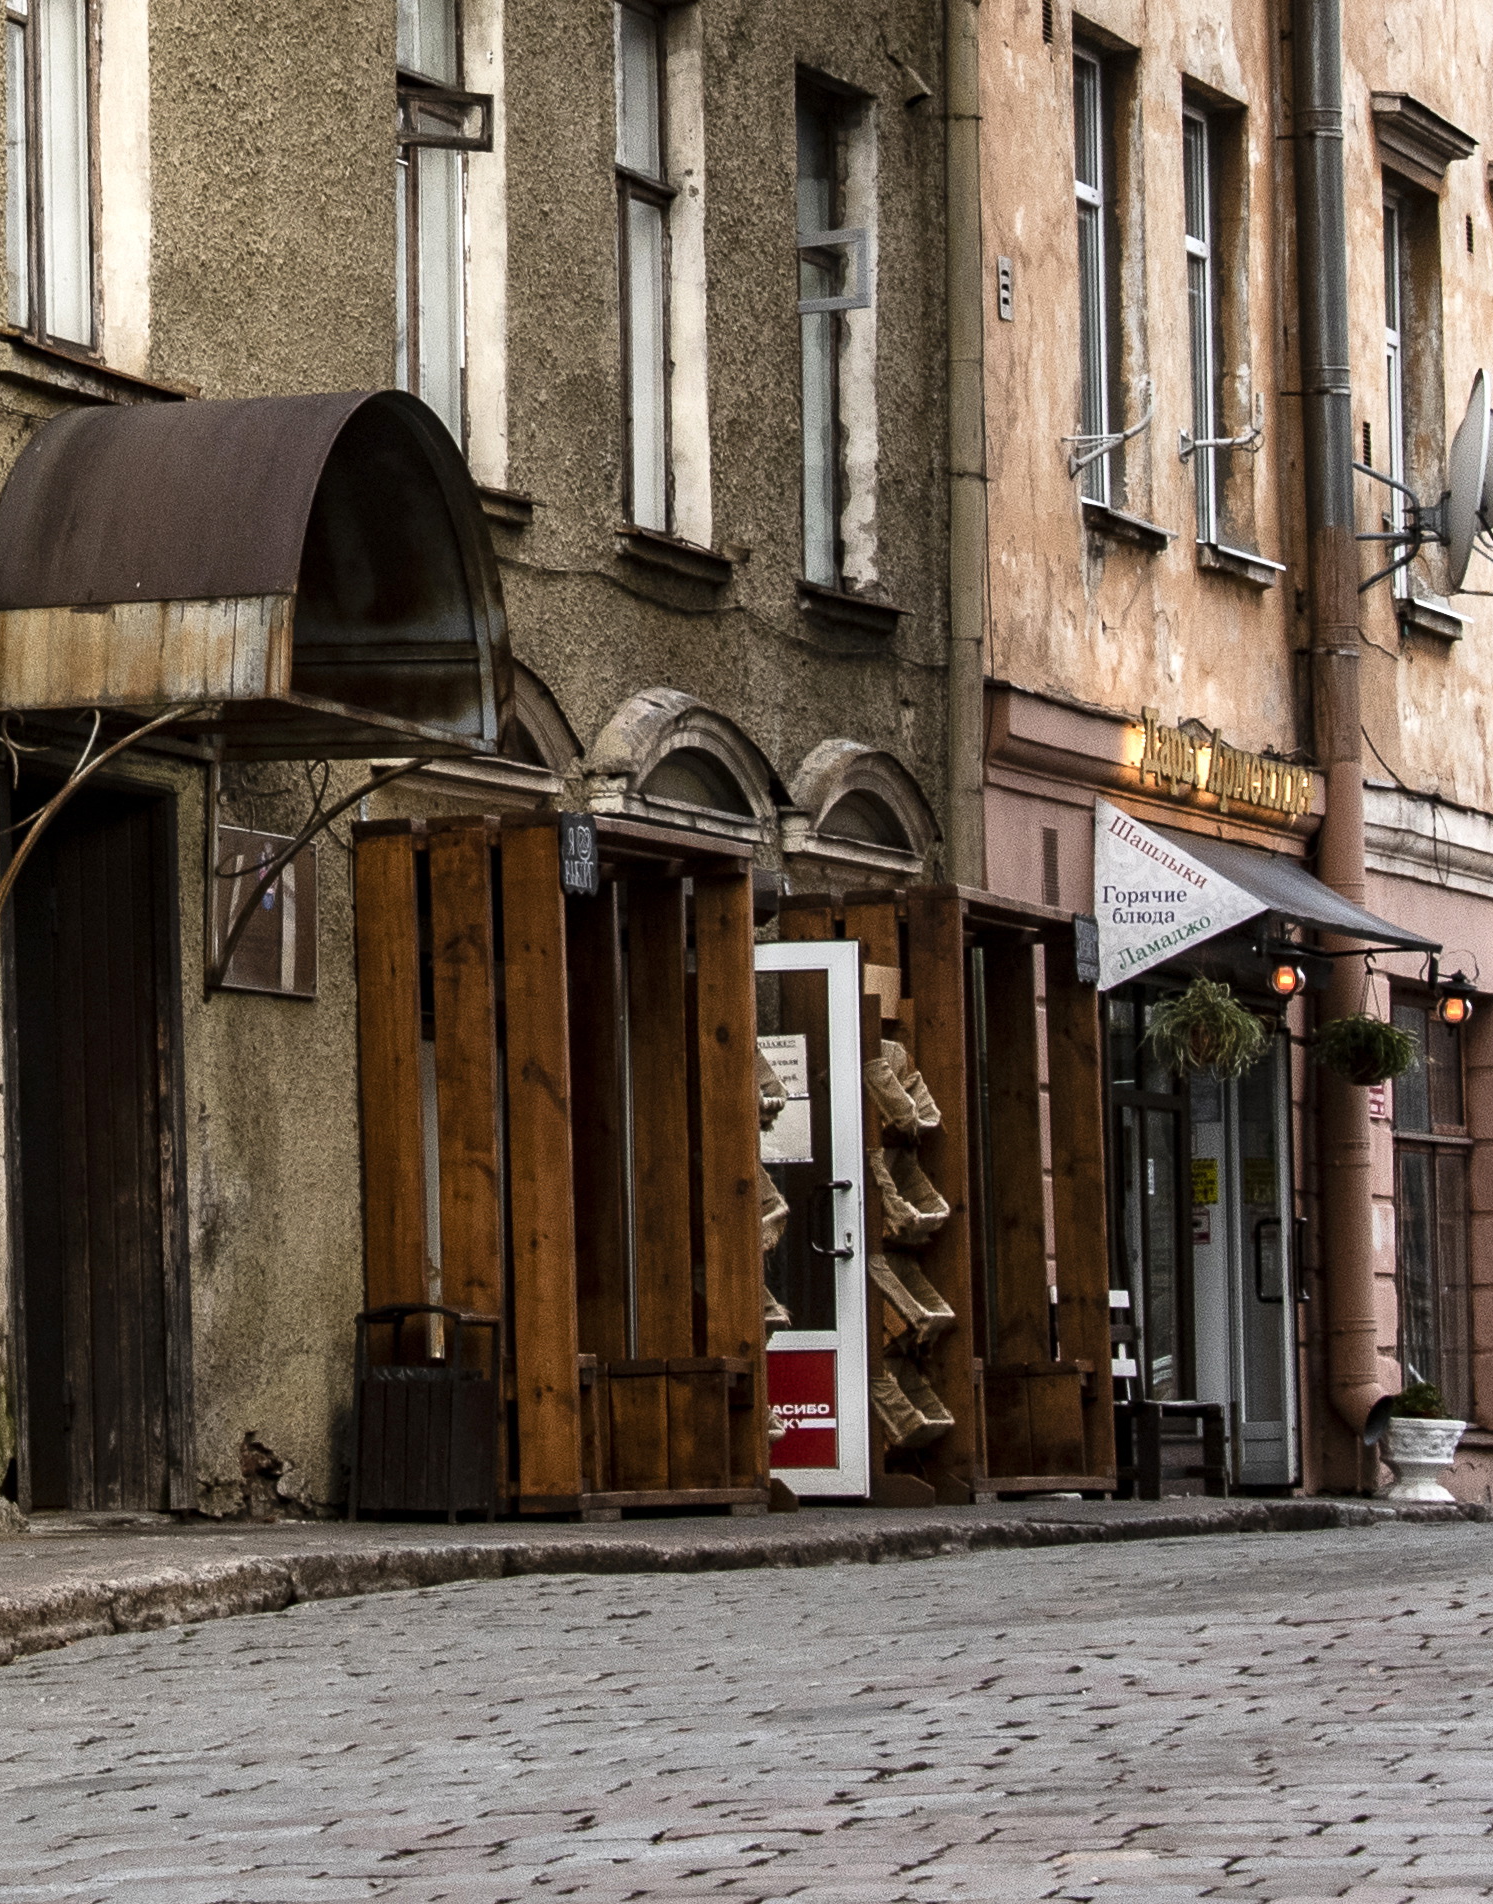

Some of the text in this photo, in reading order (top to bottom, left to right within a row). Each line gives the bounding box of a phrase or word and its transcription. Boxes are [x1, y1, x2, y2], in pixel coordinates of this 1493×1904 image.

[1139, 705, 1200, 796] Дары
[1107, 815, 1208, 890] Шашлыки
[1102, 885, 1187, 907] Горячие
[1112, 907, 1175, 925] блюда
[1116, 915, 1211, 970] Ламаджо
[768, 1403, 830, 1415] АСИБО
